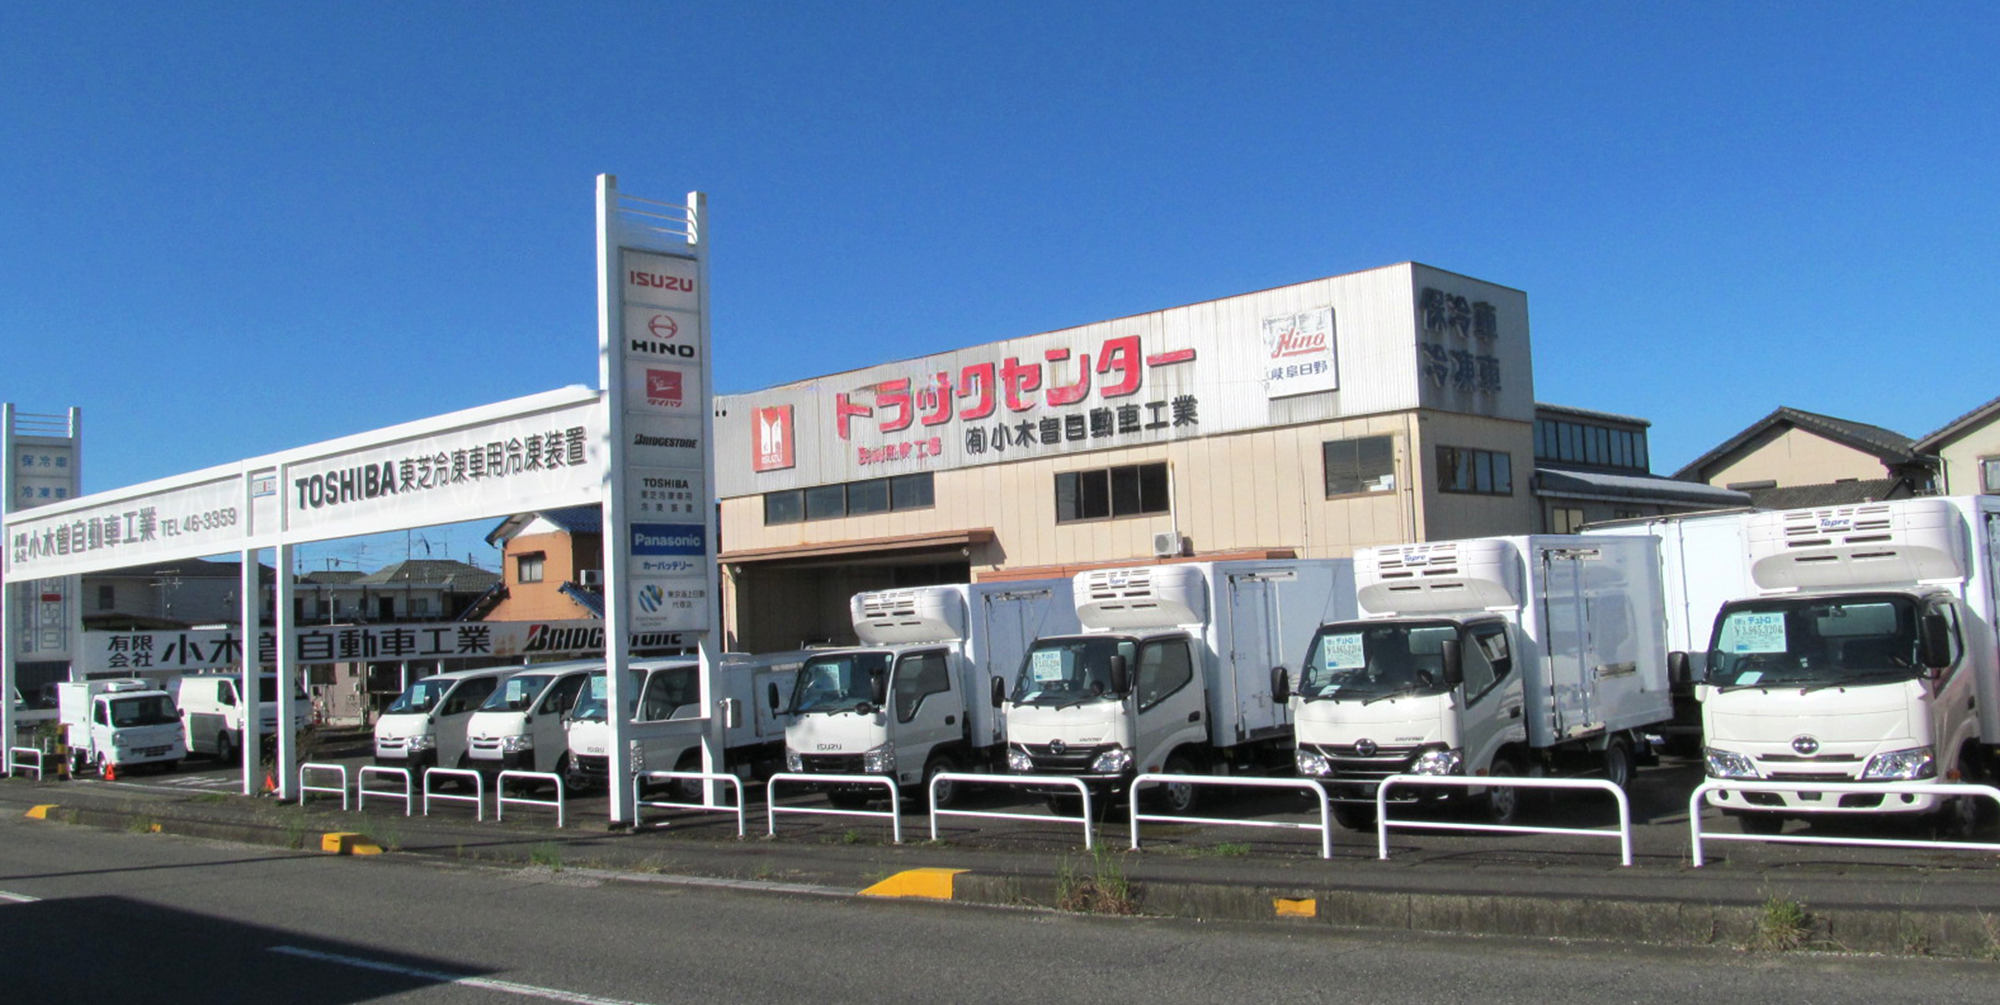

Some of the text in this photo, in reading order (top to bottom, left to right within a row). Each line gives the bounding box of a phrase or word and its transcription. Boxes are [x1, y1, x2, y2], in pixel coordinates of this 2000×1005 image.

[630, 270, 693, 292] ISUZU
[631, 339, 695, 358] HINO
[1271, 327, 1325, 359] Hino
[1271, 360, 1328, 380] 岐阜日野
[836, 334, 1197, 440] トラックセンター
[633, 433, 698, 449] BRIDGESTONE
[295, 426, 588, 509] TOSHIBA 東芝冷凍車用冷凍装置
[643, 477, 690, 489] TOSHIBA
[1820, 517, 1850, 528] Topre
[29, 507, 238, 559] 小木曽自動車工業 TEL 46-3359
[635, 533, 701, 548] Panasonic
[643, 561, 694, 571] カーバッテリー
[108, 635, 153, 652] 有限
[161, 625, 491, 665] 小木曽自動車工業
[108, 652, 153, 668] 会社
